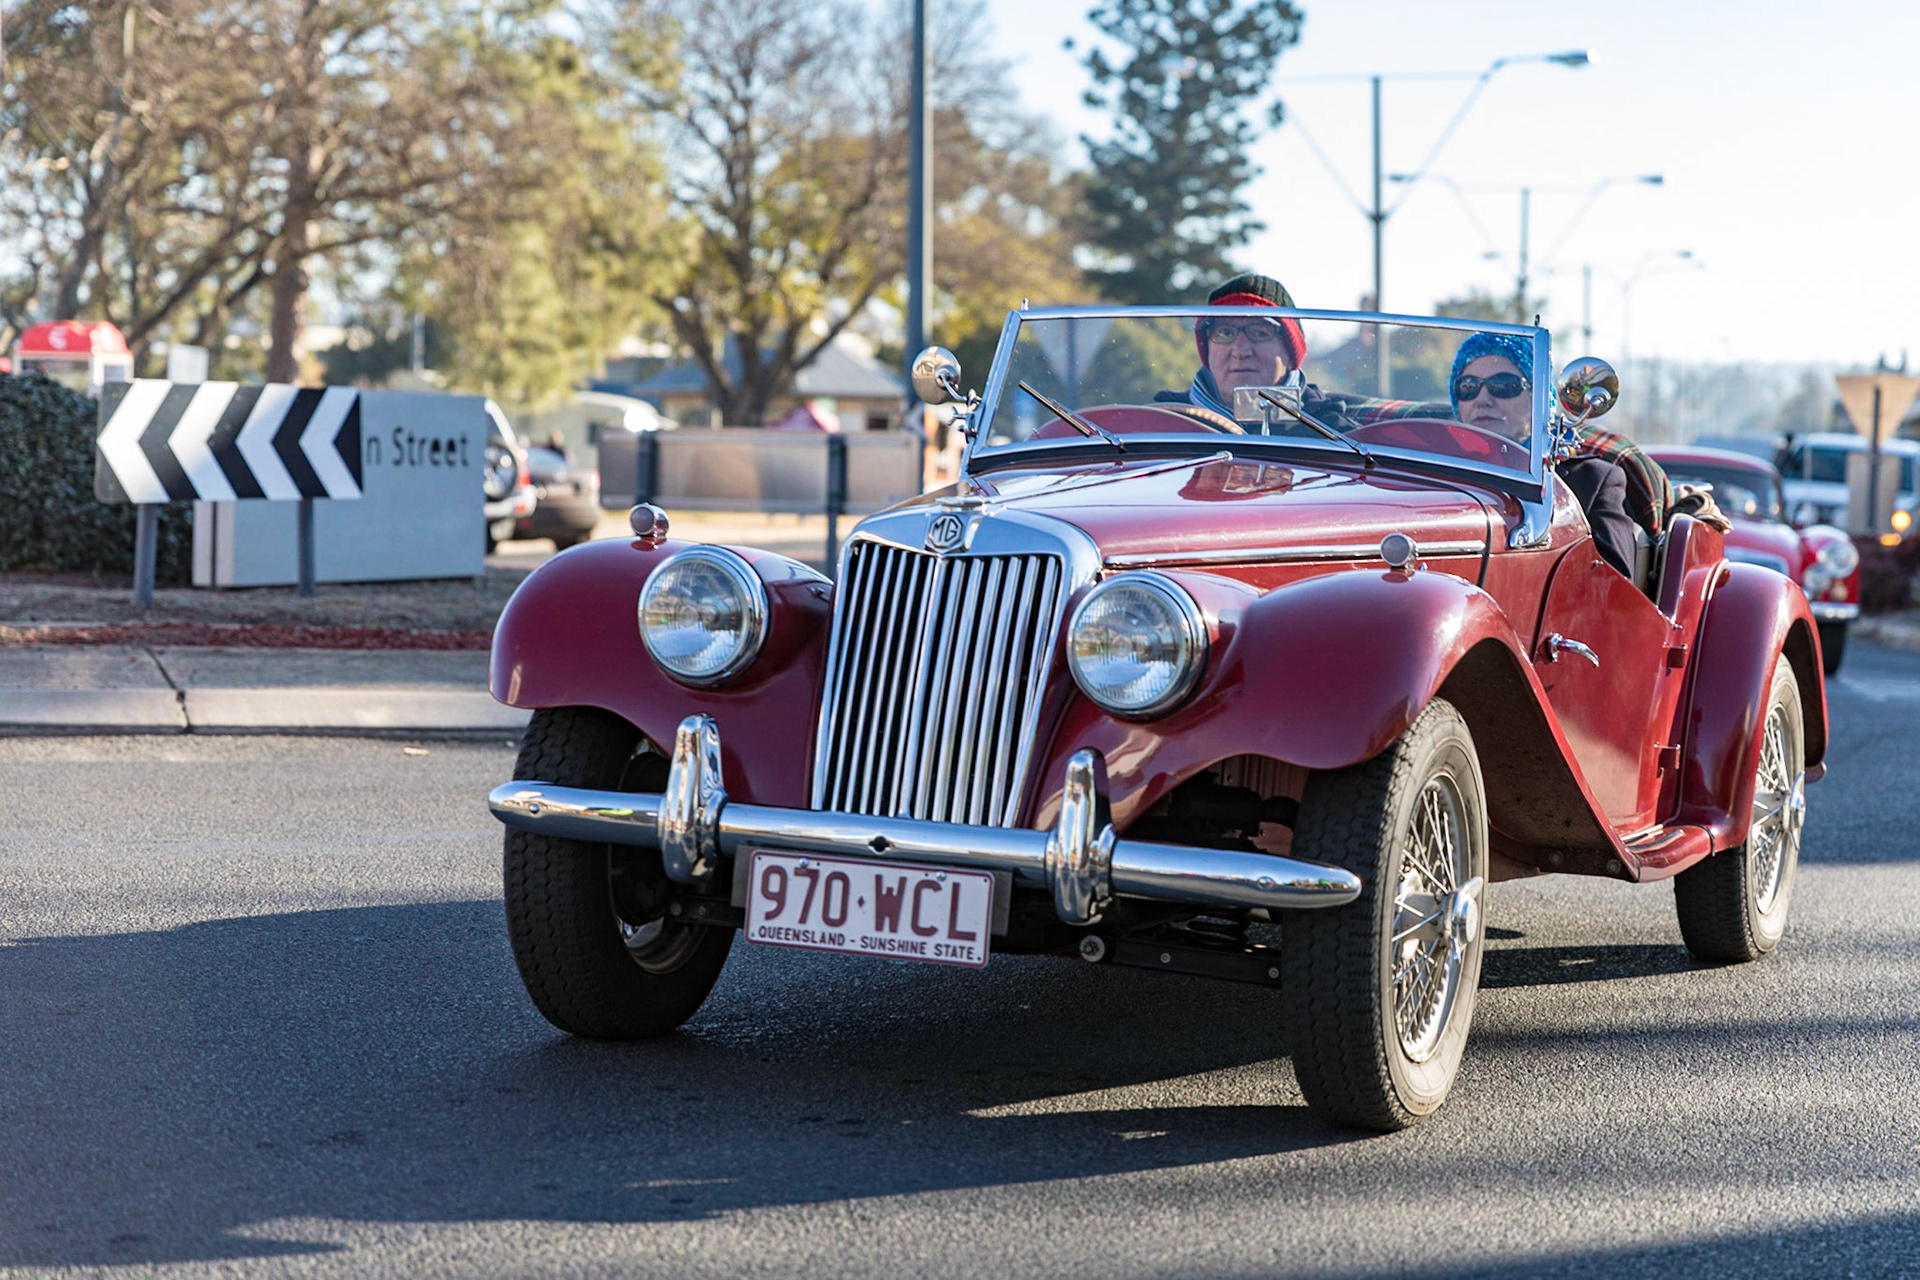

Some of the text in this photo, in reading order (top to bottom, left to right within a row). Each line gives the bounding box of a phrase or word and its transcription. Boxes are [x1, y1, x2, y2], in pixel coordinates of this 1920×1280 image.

[392, 425, 469, 466] Street
[932, 518, 959, 542] MG
[761, 865, 976, 941] 970 WCL
[758, 926, 845, 946] QUEENSLAND
[860, 936, 927, 955] SUNSHINE
[934, 945, 974, 960] STATE
